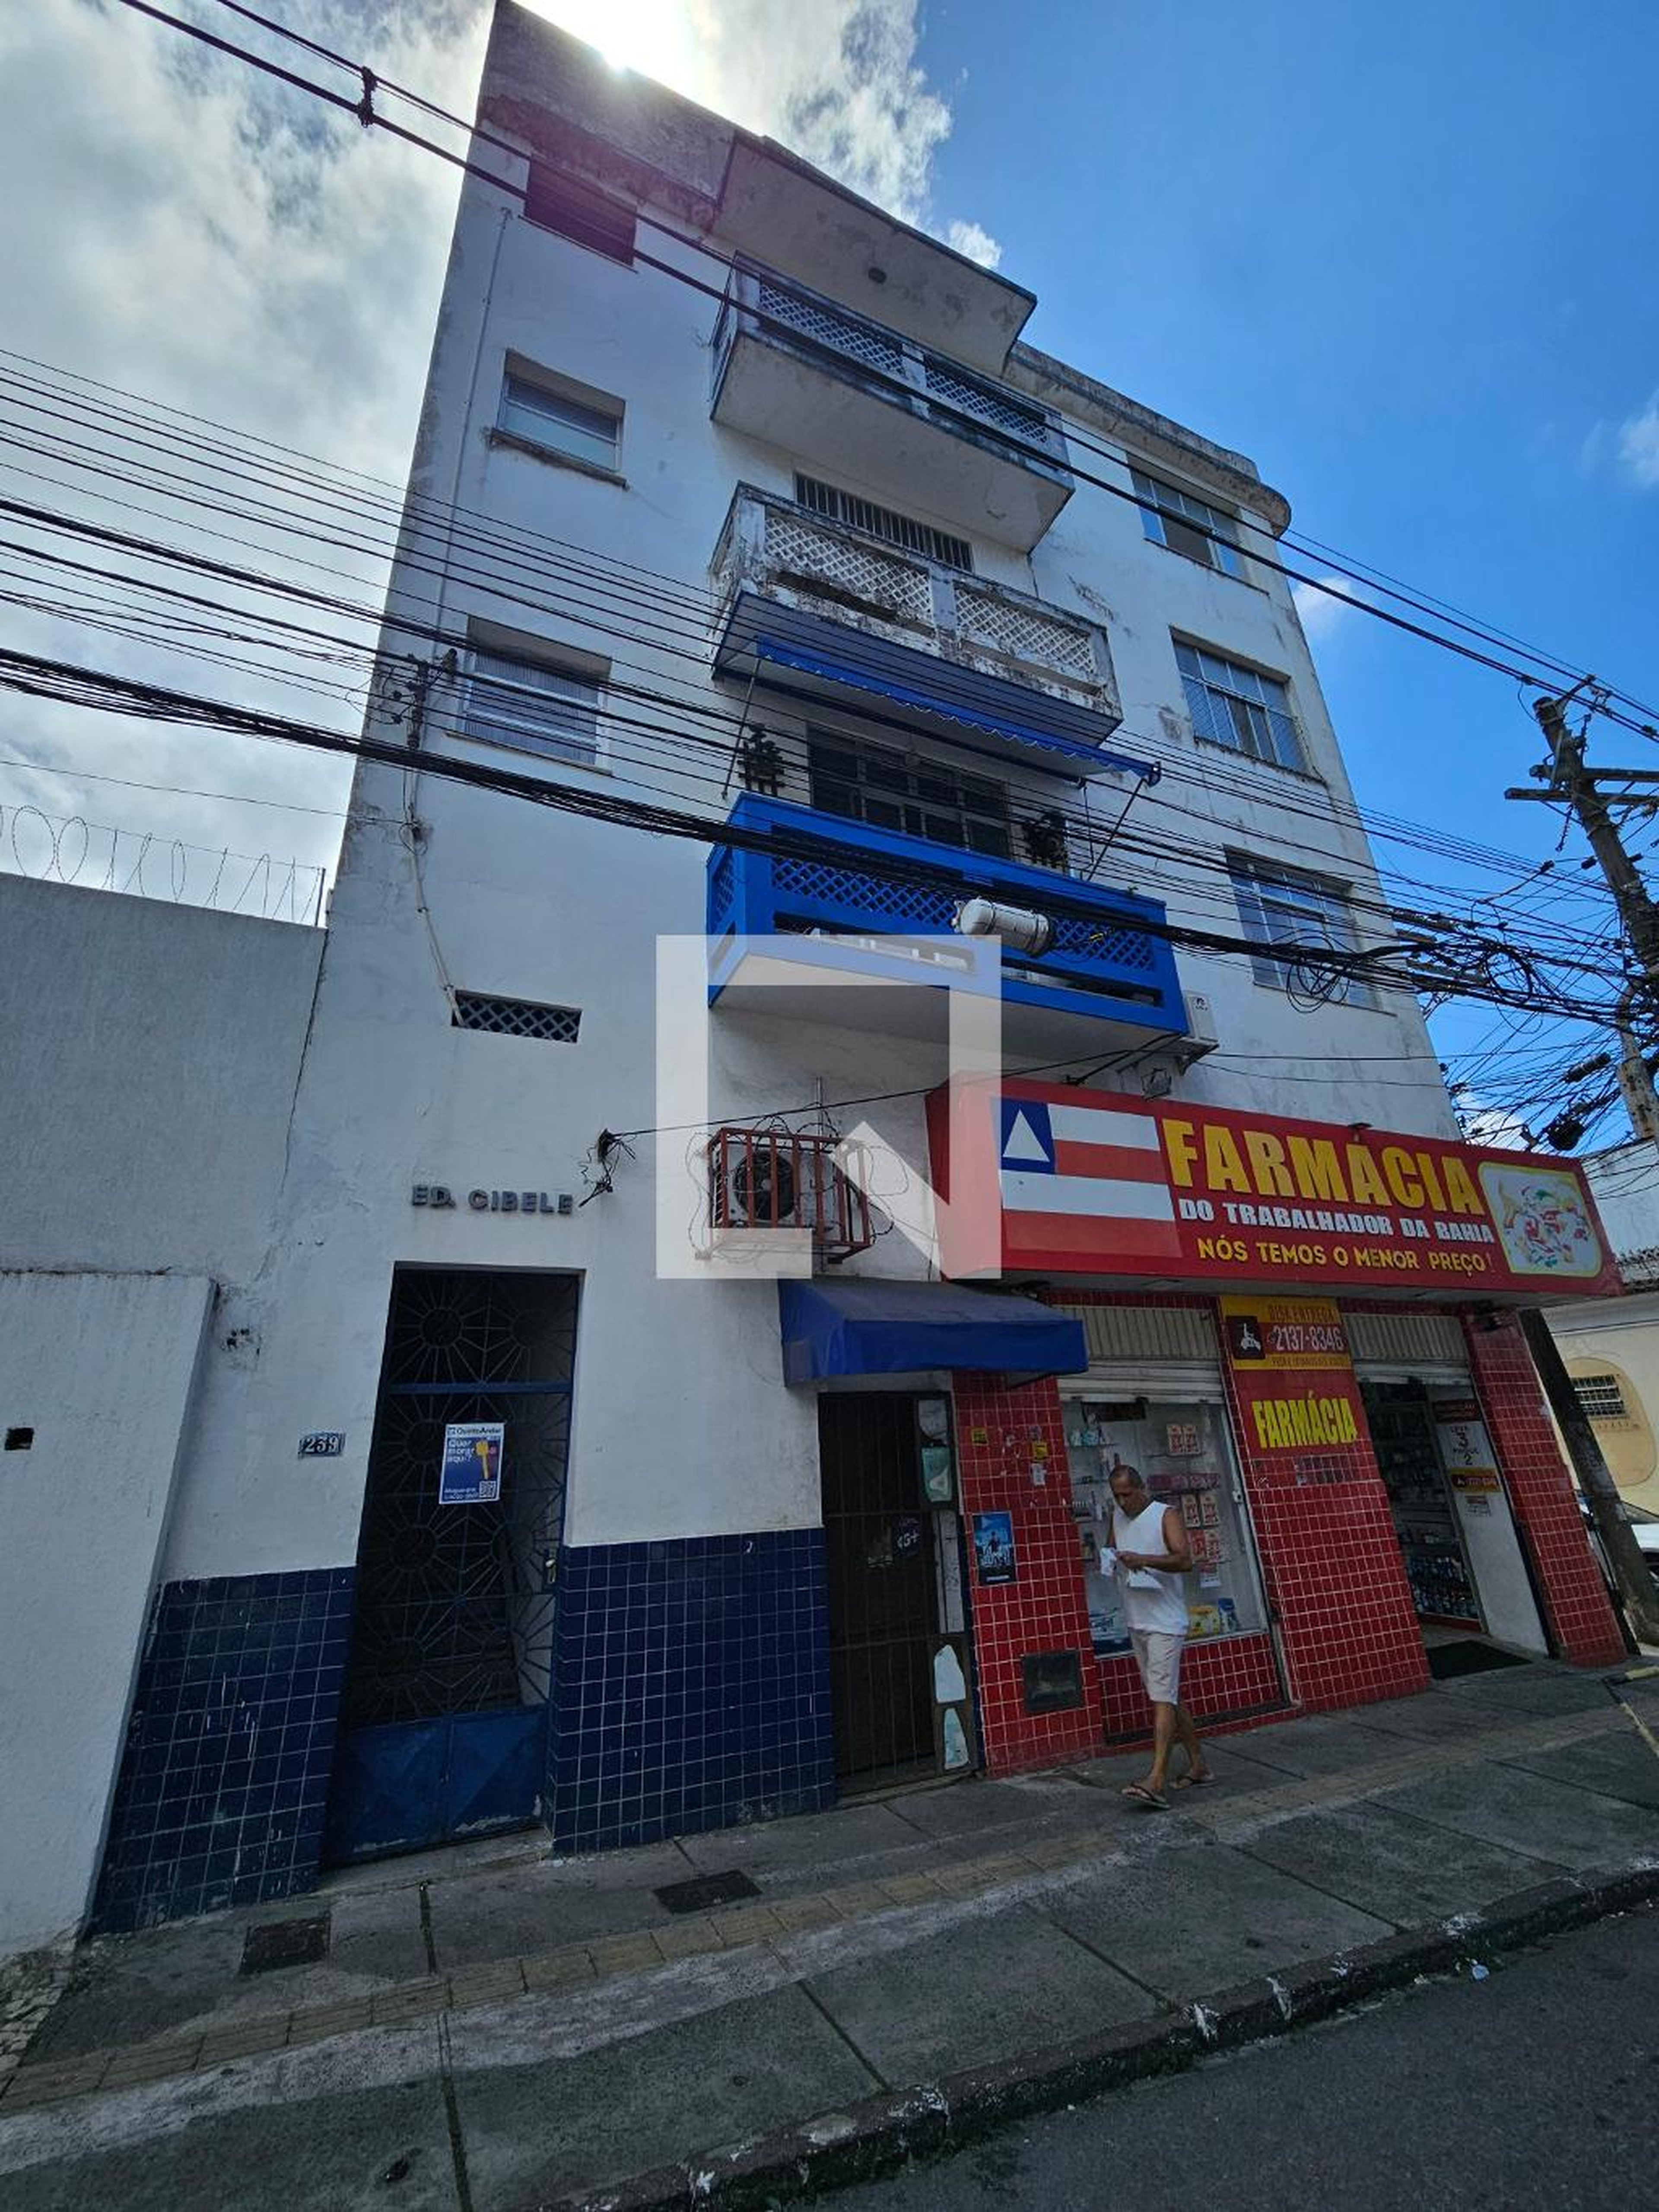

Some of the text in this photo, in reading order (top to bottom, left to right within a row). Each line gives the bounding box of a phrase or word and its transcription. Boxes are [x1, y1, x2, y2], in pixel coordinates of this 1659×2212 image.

[412, 1185, 574, 1214] ED. CIBELE
[1179, 1199, 1494, 1243] DO TRABALHADOR DA BAHIA
[1197, 1235, 1248, 1261] NÓS
[1255, 1243, 1327, 1265] TEMOS
[1333, 1246, 1349, 1267] O
[1353, 1247, 1420, 1270] MENOR
[1252, 1390, 1357, 1448] FARMÁCIA
[305, 1435, 339, 1453] 239
[1464, 1453, 1473, 1466] 2
